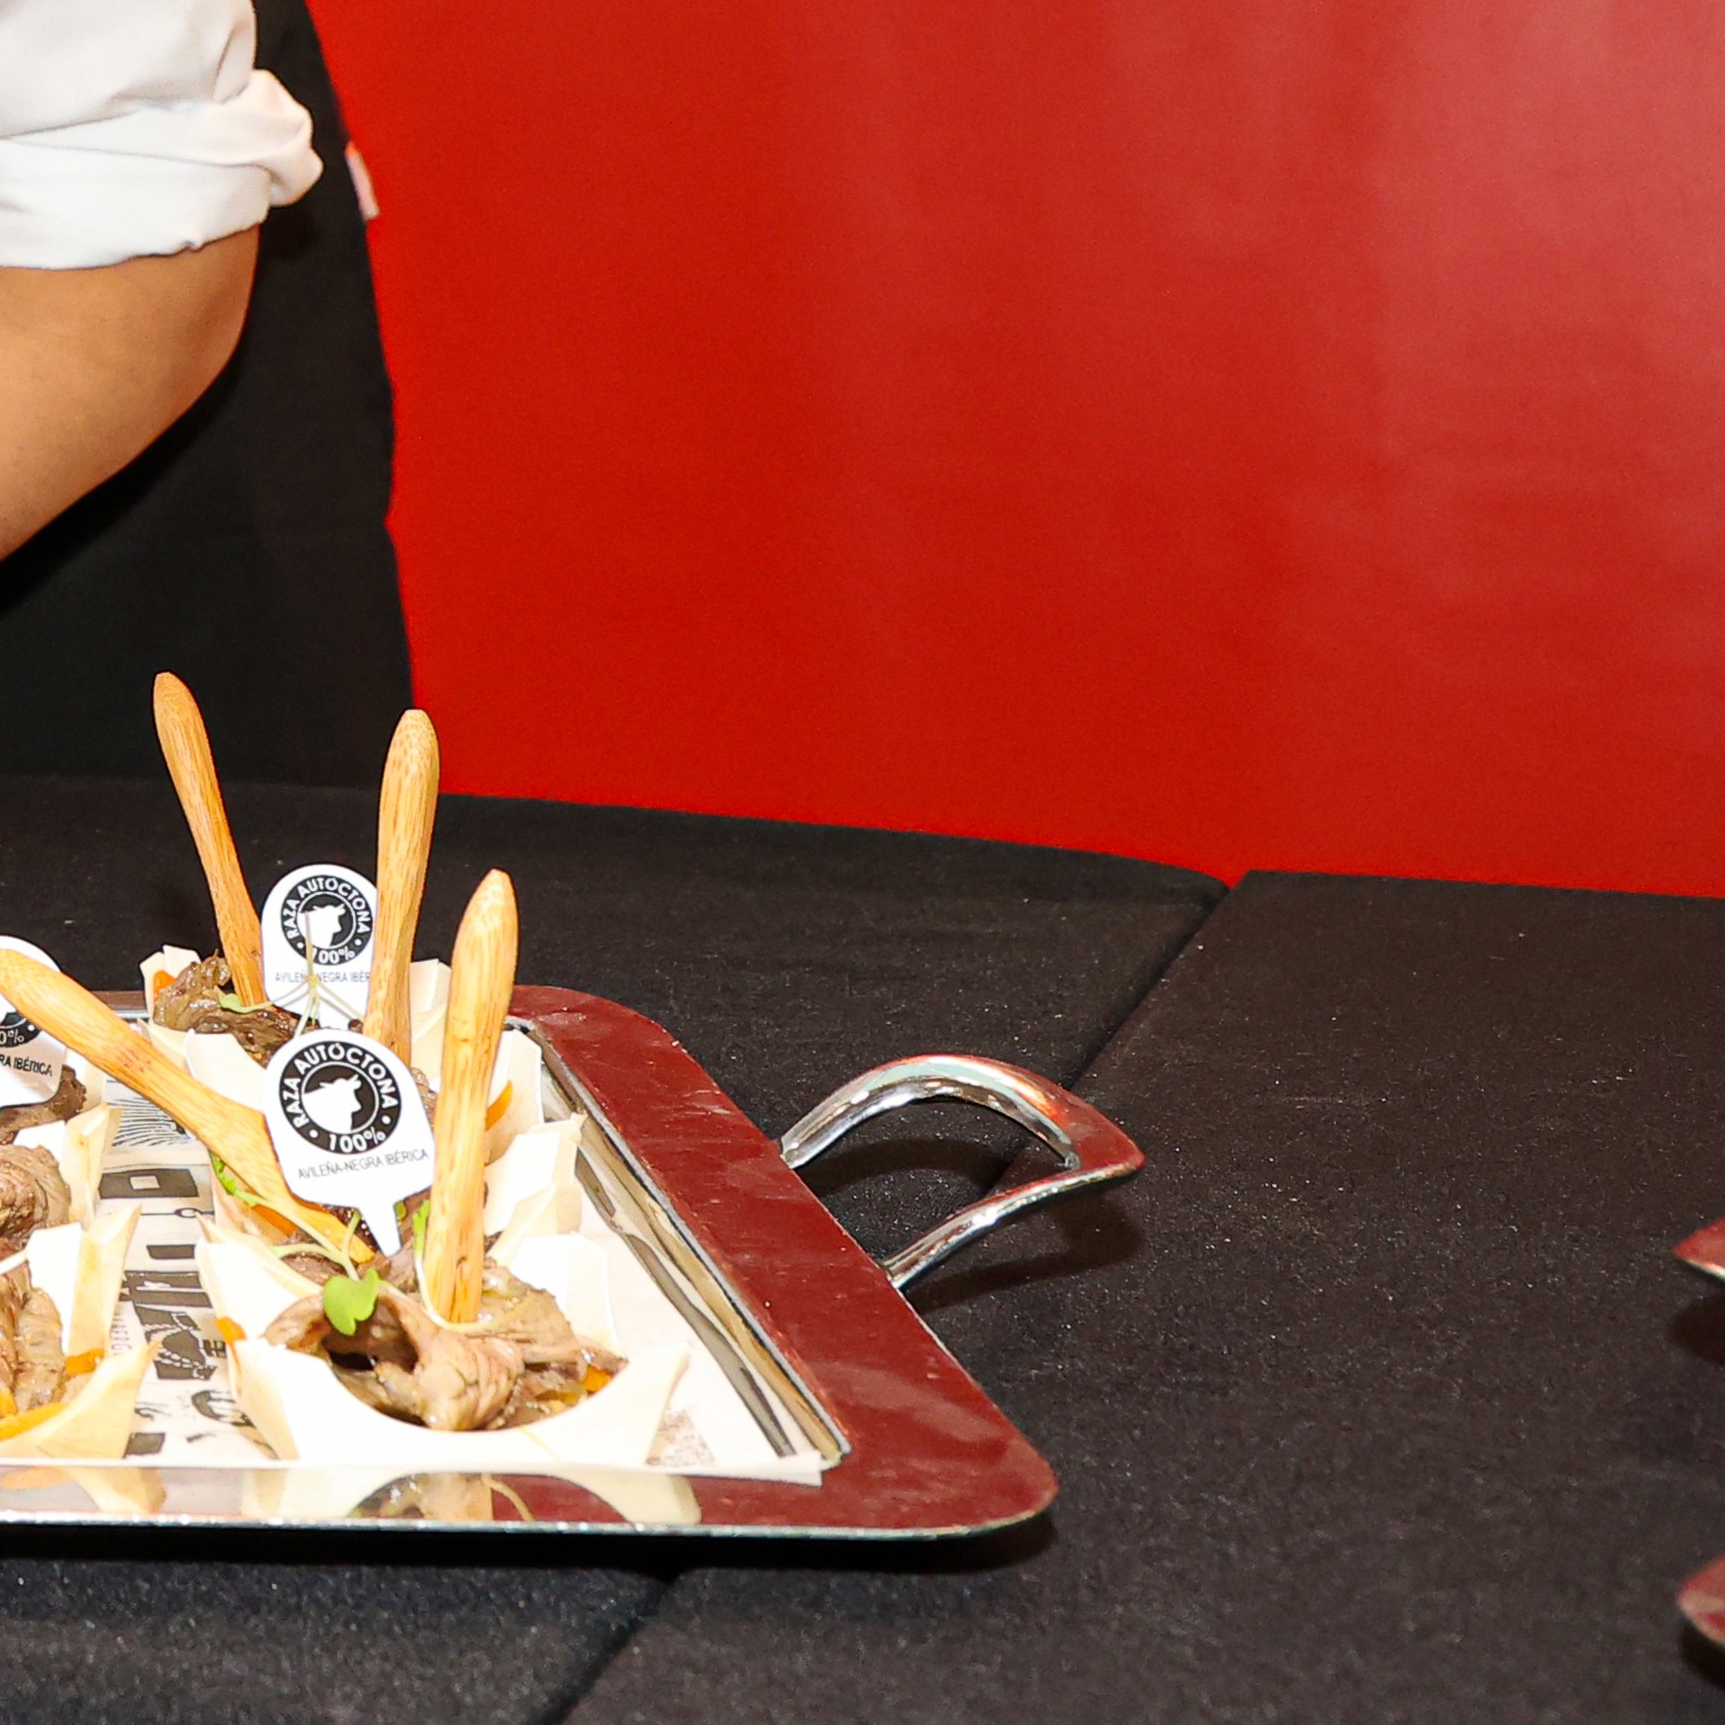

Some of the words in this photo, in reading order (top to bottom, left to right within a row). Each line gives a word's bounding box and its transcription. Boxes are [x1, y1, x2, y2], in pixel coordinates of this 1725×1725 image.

[283, 899, 300, 939] RAZA
[13, 1056, 53, 1077] IBÉRICA
[283, 1077, 310, 1128] RAZA
[329, 1127, 386, 1153] 100%
[298, 1156, 384, 1179] AVILEÑA-NEGRA
[386, 1149, 430, 1165] IBÉRICA
